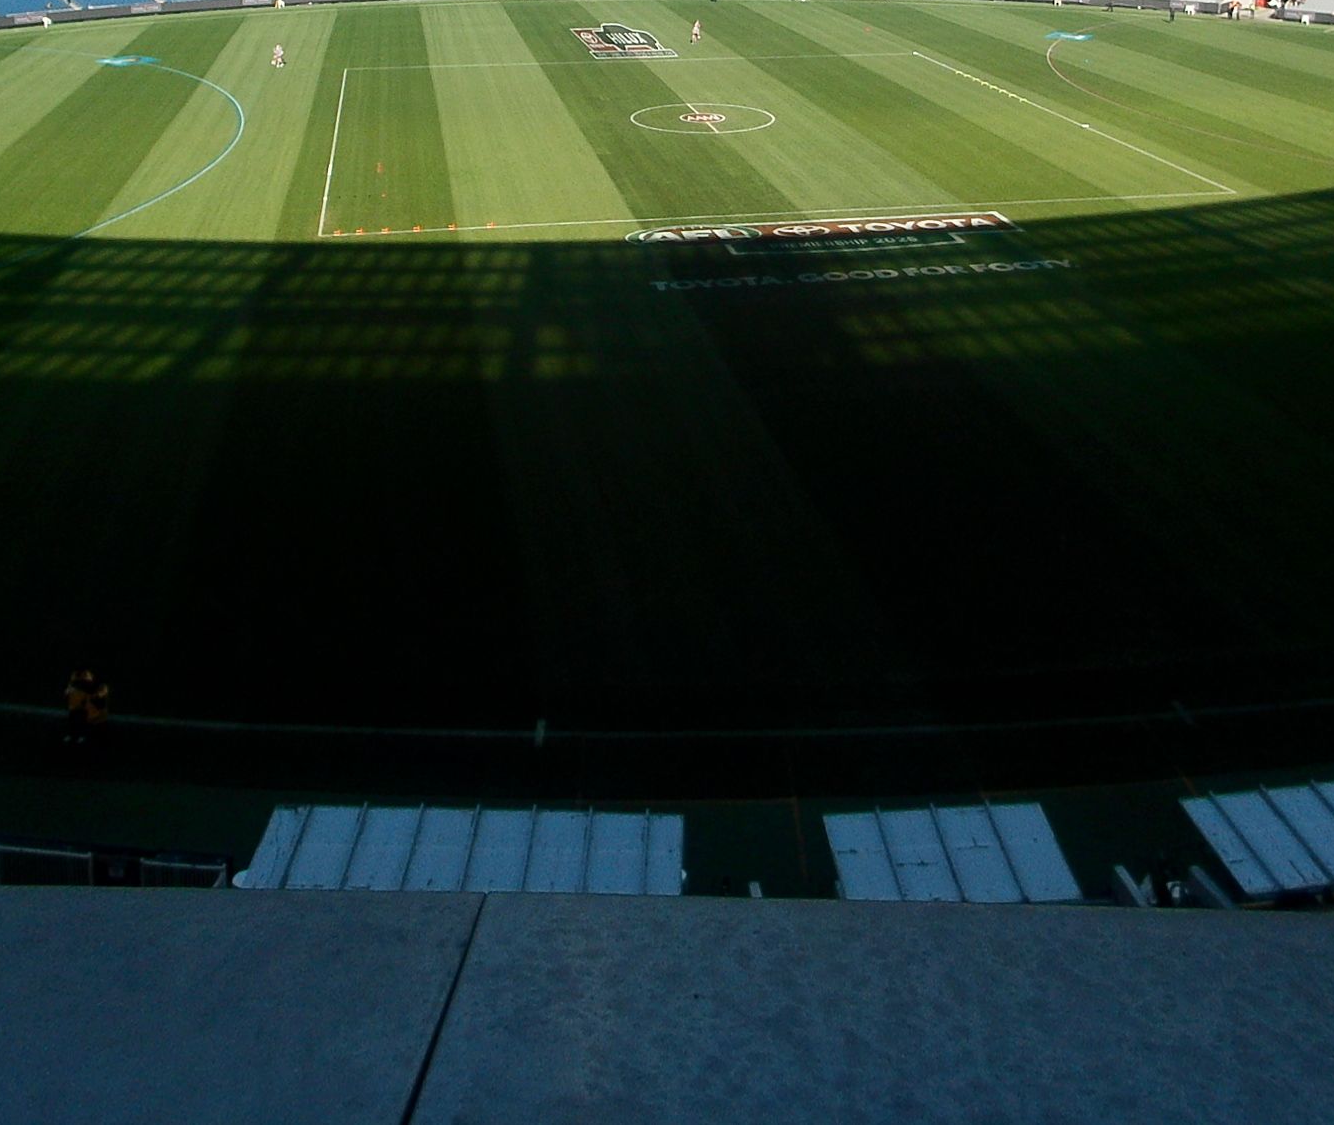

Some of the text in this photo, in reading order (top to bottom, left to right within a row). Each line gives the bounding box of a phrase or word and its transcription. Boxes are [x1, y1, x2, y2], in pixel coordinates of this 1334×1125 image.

[606, 32, 648, 45] HILUX
[643, 217, 998, 244] AFL TOYOTA
[797, 268, 899, 283] GOOD
[903, 262, 968, 277] FOR
